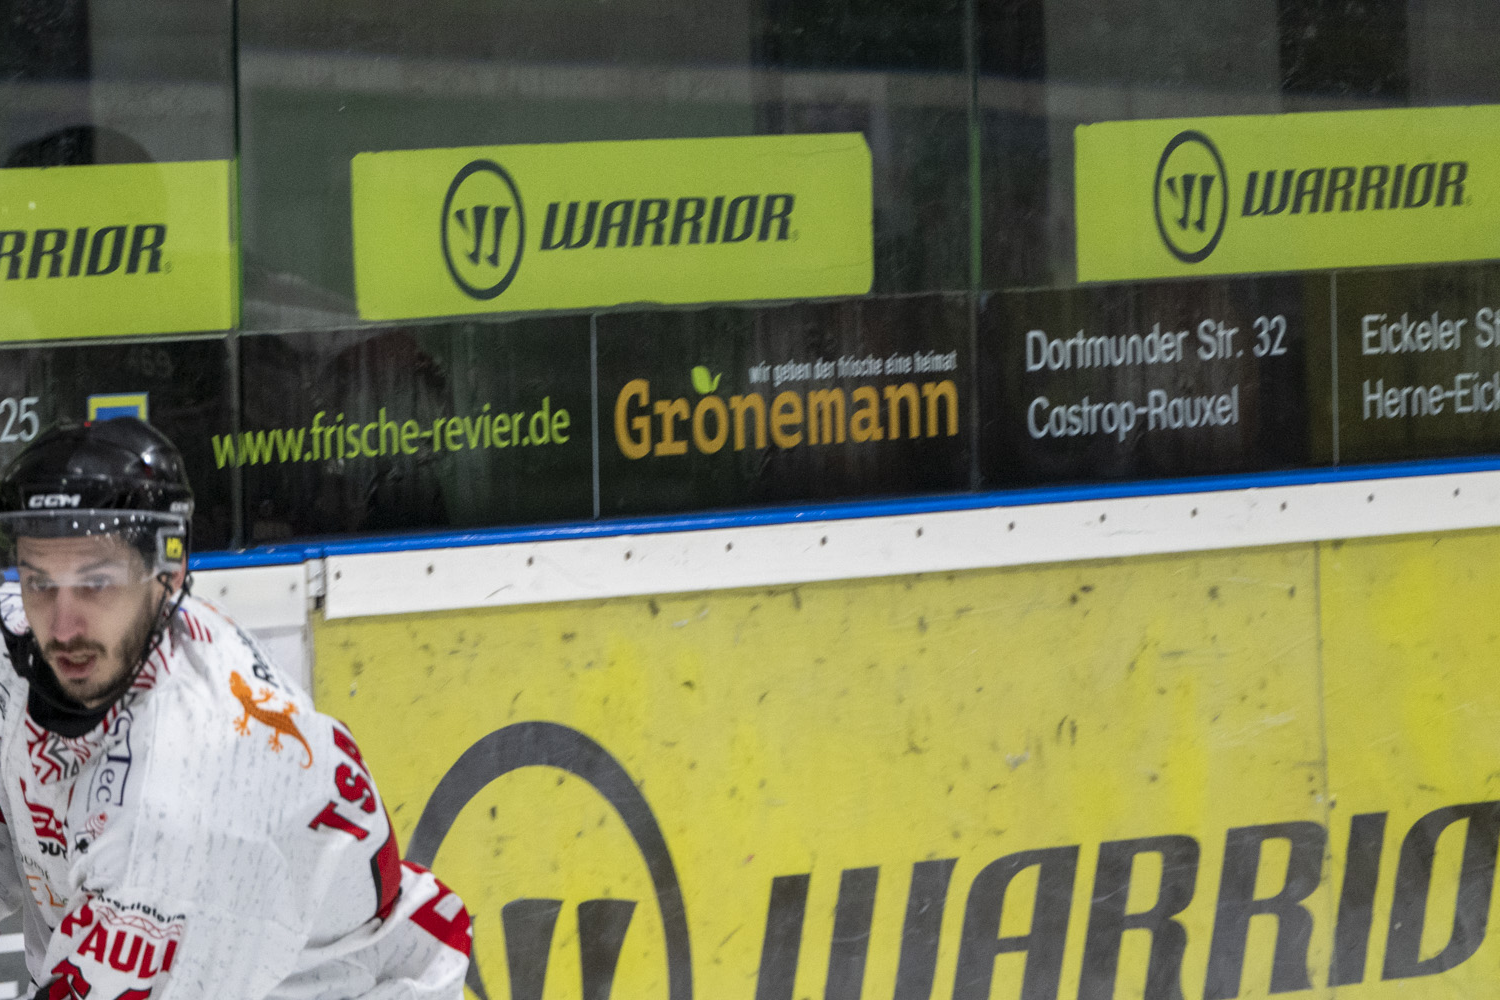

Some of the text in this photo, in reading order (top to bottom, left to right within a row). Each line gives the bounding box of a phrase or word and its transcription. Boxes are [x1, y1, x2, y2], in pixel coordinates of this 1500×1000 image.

[1241, 161, 1469, 217] WARRIOR
[539, 193, 796, 251] WARRIOR
[1025, 314, 1288, 373] Dortmunder Str. 32
[1361, 311, 1468, 355] Eickeler
[748, 350, 959, 388] wir geben der frische eine heimat
[211, 395, 571, 469] www.frische-revier.de
[1027, 383, 1240, 442] Castrop-Rauxel
[28, 494, 81, 508] CCM
